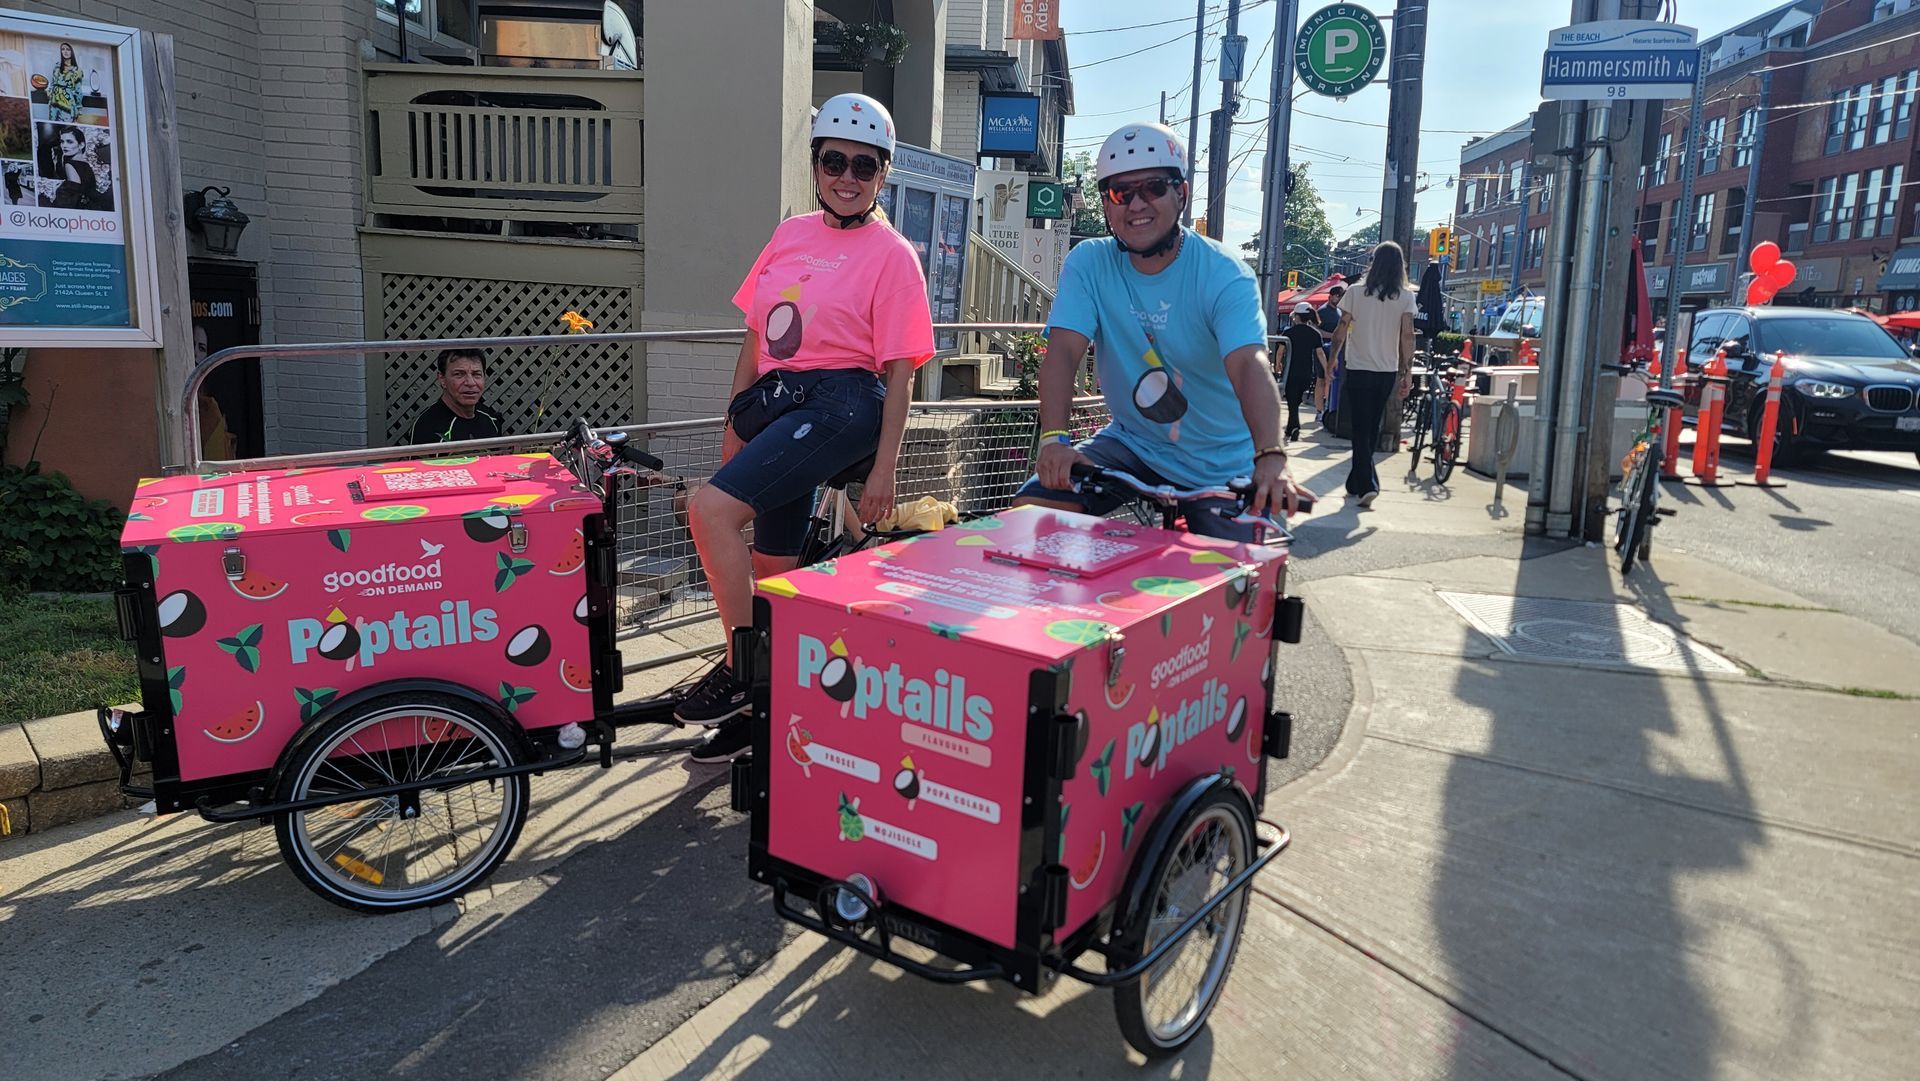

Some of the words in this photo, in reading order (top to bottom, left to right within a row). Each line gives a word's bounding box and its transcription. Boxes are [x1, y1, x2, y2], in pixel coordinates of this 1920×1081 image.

[1299, 8, 1381, 49] MUNICIPAL
[1561, 33, 1575, 42] THE
[1576, 32, 1601, 41] BEACH
[1325, 29, 1359, 65] P
[1300, 57, 1380, 93] PARKING
[1548, 55, 1671, 78] Hammersmith
[1676, 59, 1694, 77] Av
[1607, 86, 1627, 98] 98
[988, 117, 1012, 127] MCA
[10, 211, 117, 233] @kokophoto
[74, 289, 95, 297] Queen
[323, 558, 442, 593] goodfood
[366, 586, 385, 597] ON
[388, 580, 443, 595] DEMAND
[1150, 633, 1211, 690] goodfood
[1180, 658, 1209, 683] DEMAND
[922, 733, 970, 756] FLAVOURS
[953, 795, 991, 815] COLADA
